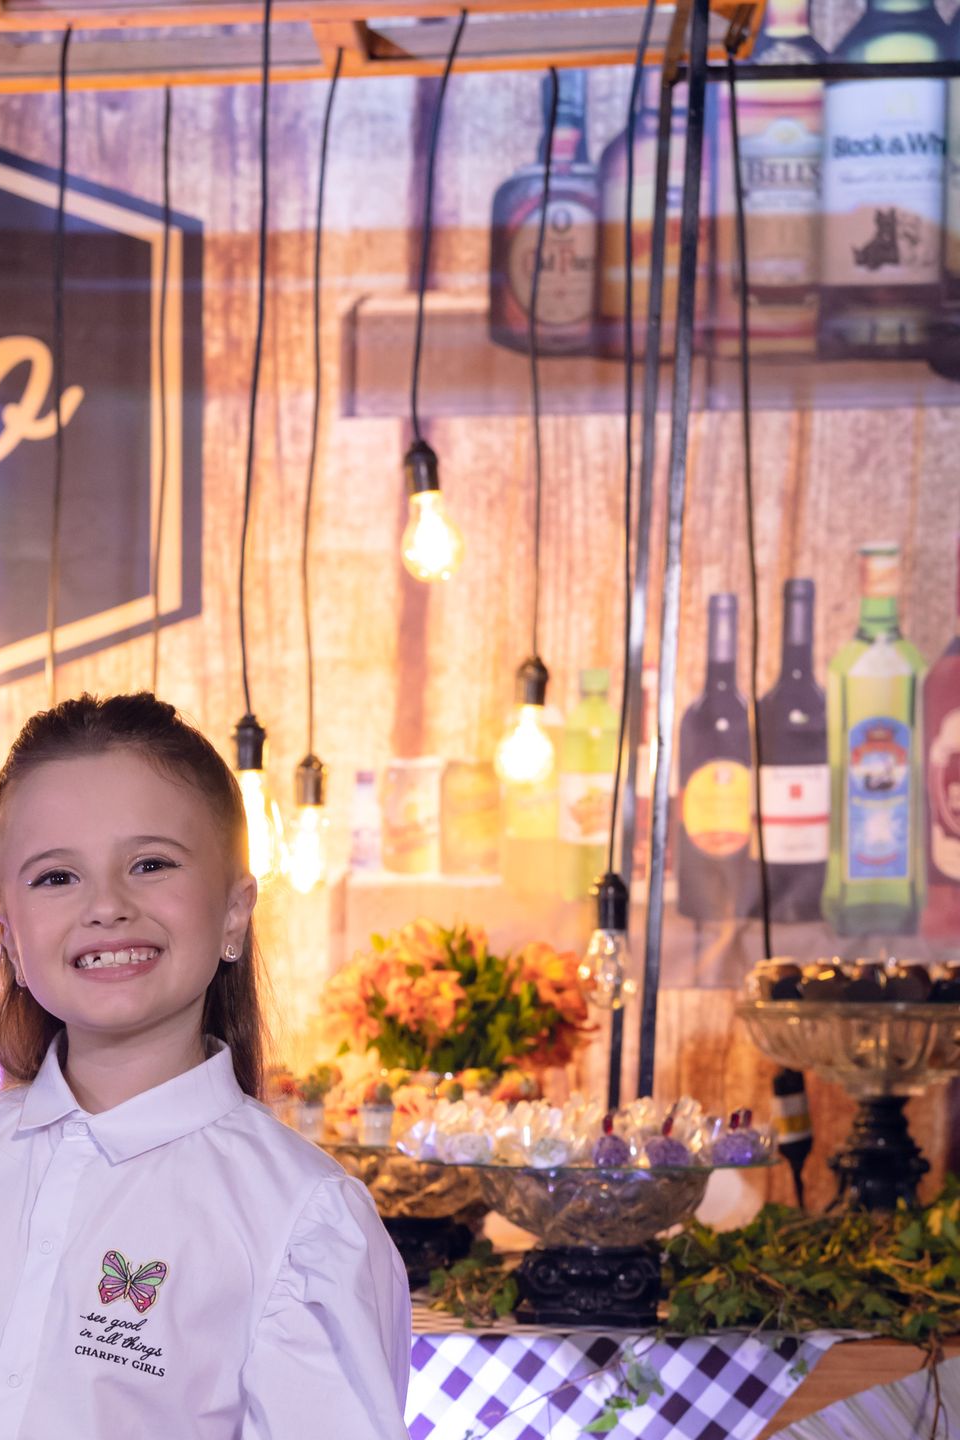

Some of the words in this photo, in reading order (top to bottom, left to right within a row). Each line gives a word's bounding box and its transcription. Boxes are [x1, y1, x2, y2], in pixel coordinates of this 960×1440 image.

[104, 1318, 148, 1332] good
[80, 1328, 93, 1338] in
[96, 1332, 124, 1345] all
[121, 1336, 163, 1361] things
[74, 1345, 129, 1366] CHARPEY
[131, 1360, 166, 1377] GIRLS
